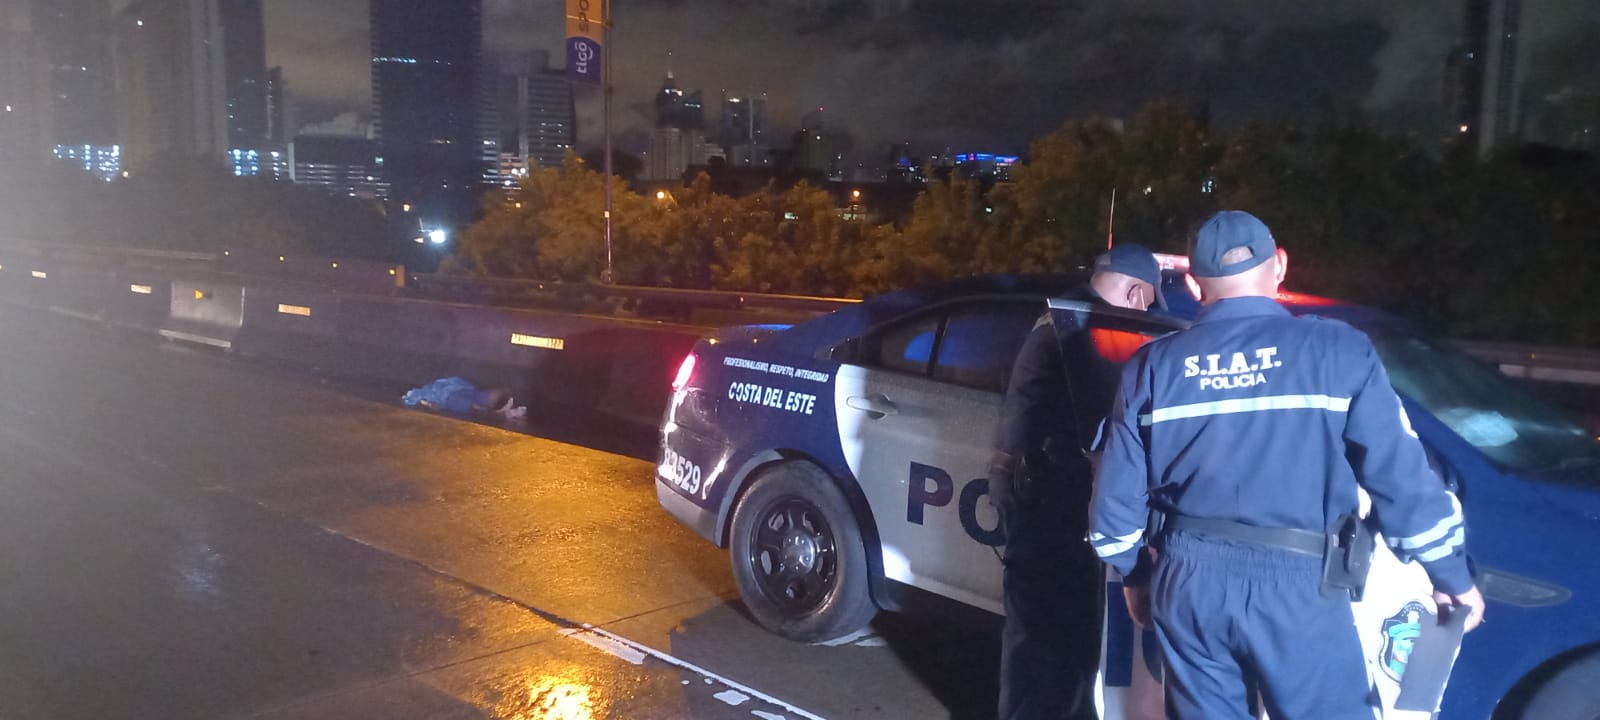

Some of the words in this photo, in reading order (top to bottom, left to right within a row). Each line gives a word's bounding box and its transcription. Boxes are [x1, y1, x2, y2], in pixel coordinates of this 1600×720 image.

[794, 368, 829, 383] INTEGRIDAD
[728, 381, 762, 404] COSTA
[763, 387, 783, 408] DEL
[785, 391, 816, 415] ESTE
